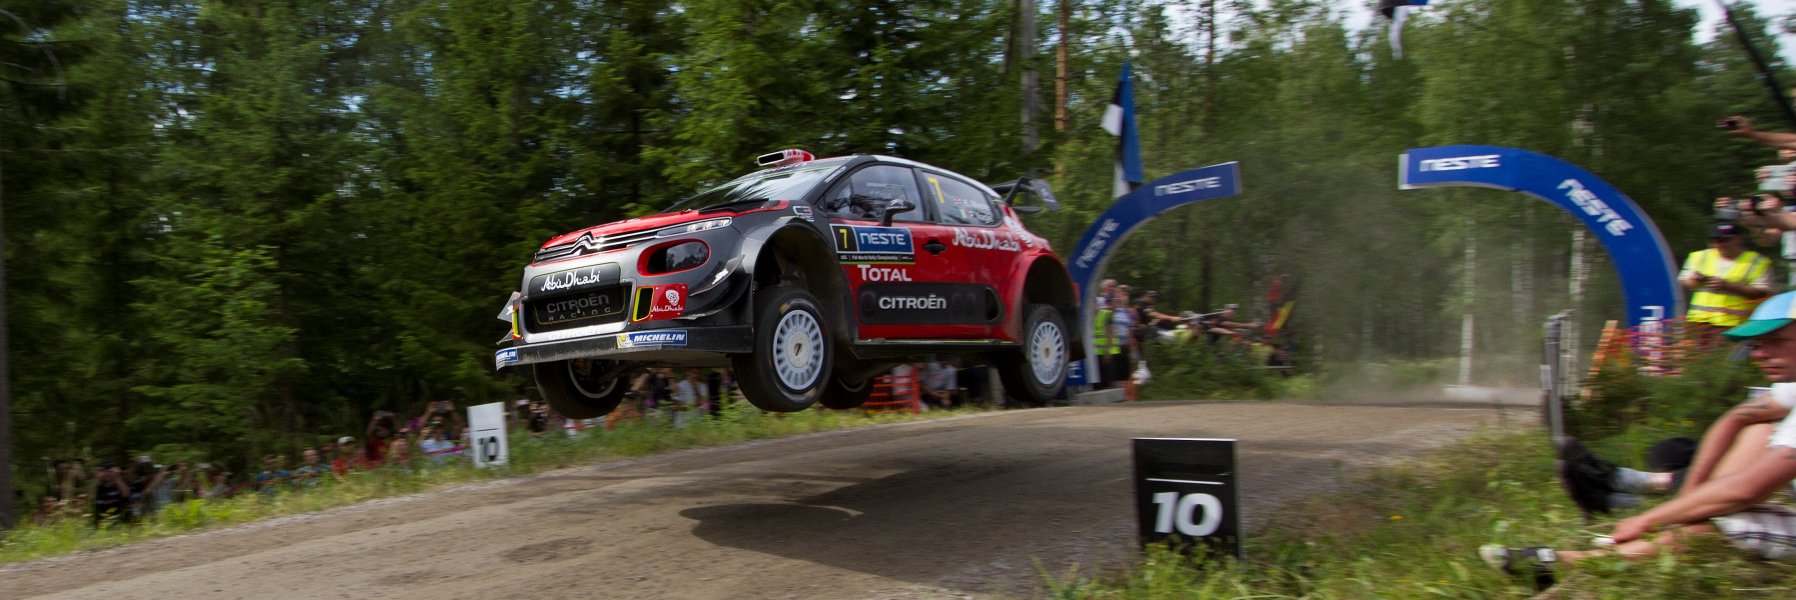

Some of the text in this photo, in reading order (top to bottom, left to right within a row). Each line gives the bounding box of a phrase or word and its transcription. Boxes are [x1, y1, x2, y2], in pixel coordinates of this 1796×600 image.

[1419, 154, 1501, 172] NESTE
[928, 177, 944, 203] 7
[1154, 176, 1221, 196] NESTE
[1556, 178, 1634, 236] NESTE
[839, 228, 906, 249] 7 NESTE
[1075, 218, 1120, 268] NESTE
[857, 264, 913, 282] TOTAL
[634, 333, 685, 342] MICHELIN
[477, 436, 500, 462] 10
[1152, 492, 1223, 537] 10
